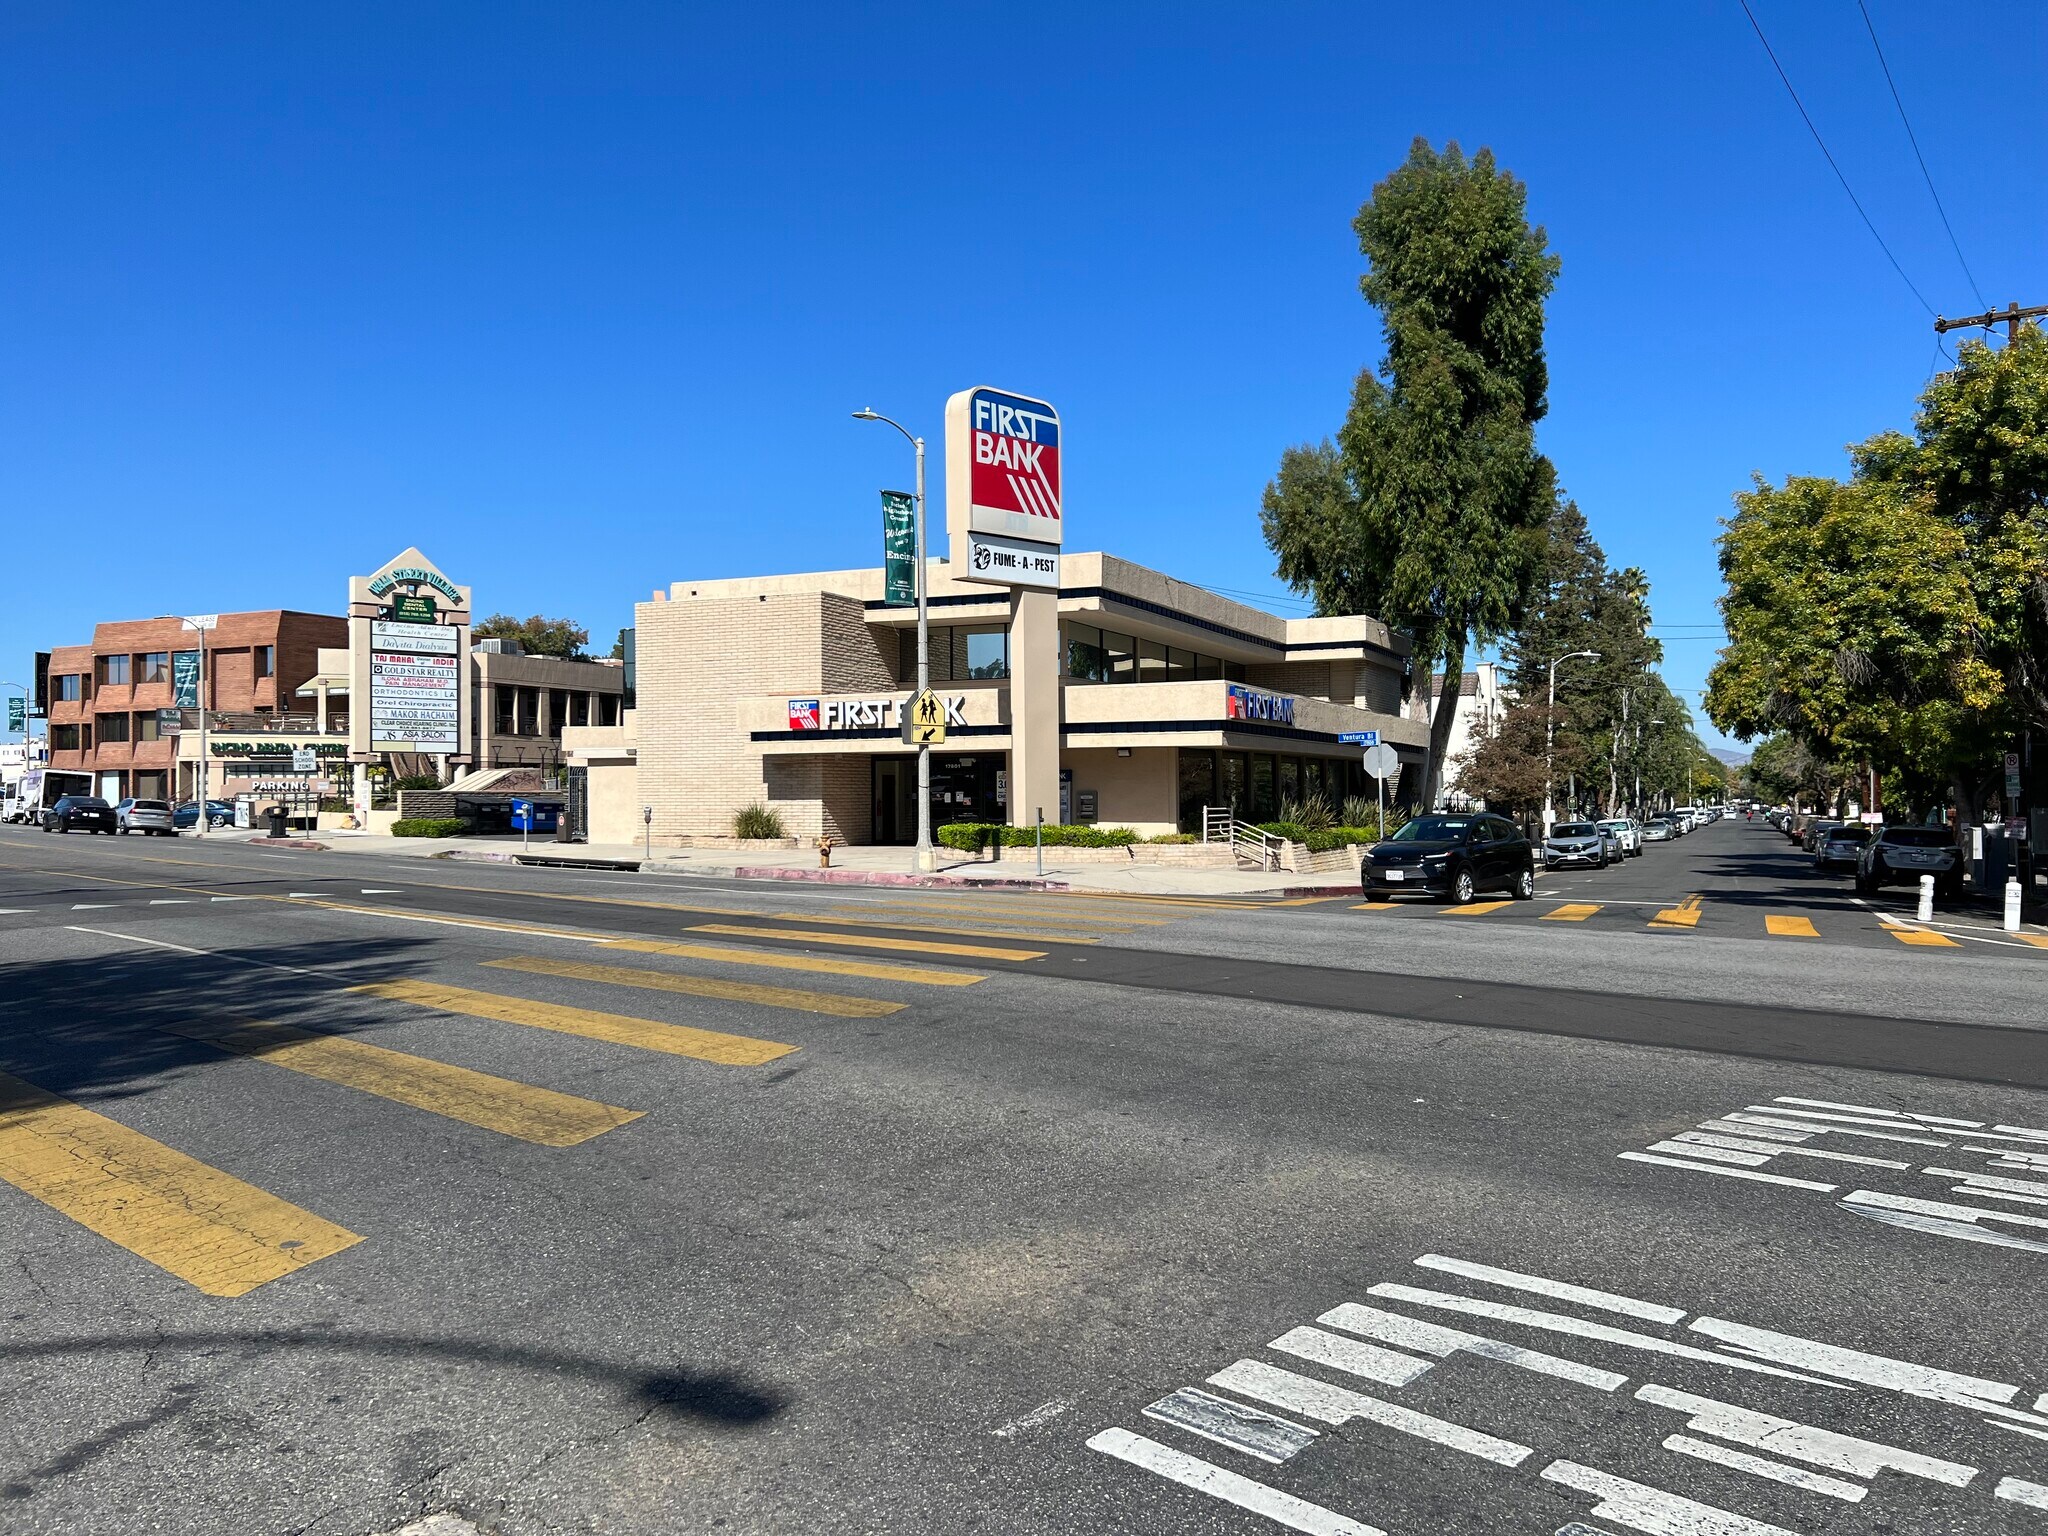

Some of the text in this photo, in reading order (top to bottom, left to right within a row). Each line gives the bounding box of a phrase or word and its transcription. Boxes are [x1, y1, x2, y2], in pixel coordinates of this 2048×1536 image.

[976, 399, 1059, 442] FIRST
[367, 568, 460, 601] WALL STREET VILLAGE
[382, 637, 448, 652] DaVita Dialysis
[374, 654, 388, 662] TAJ
[389, 655, 415, 664] MAHAL
[432, 658, 455, 666] INDIA
[384, 666, 455, 677] GOLD STAR REALTY
[374, 688, 439, 697] ORTHODONTICS
[790, 701, 817, 710] FIRST
[1248, 692, 1294, 726] FIRST BANK
[390, 709, 455, 720] MAKOR HACHAIM
[824, 700, 890, 728] FIRST
[421, 731, 446, 739] SALON
[1342, 733, 1365, 742] Ventura
[252, 780, 309, 791] PARKING
